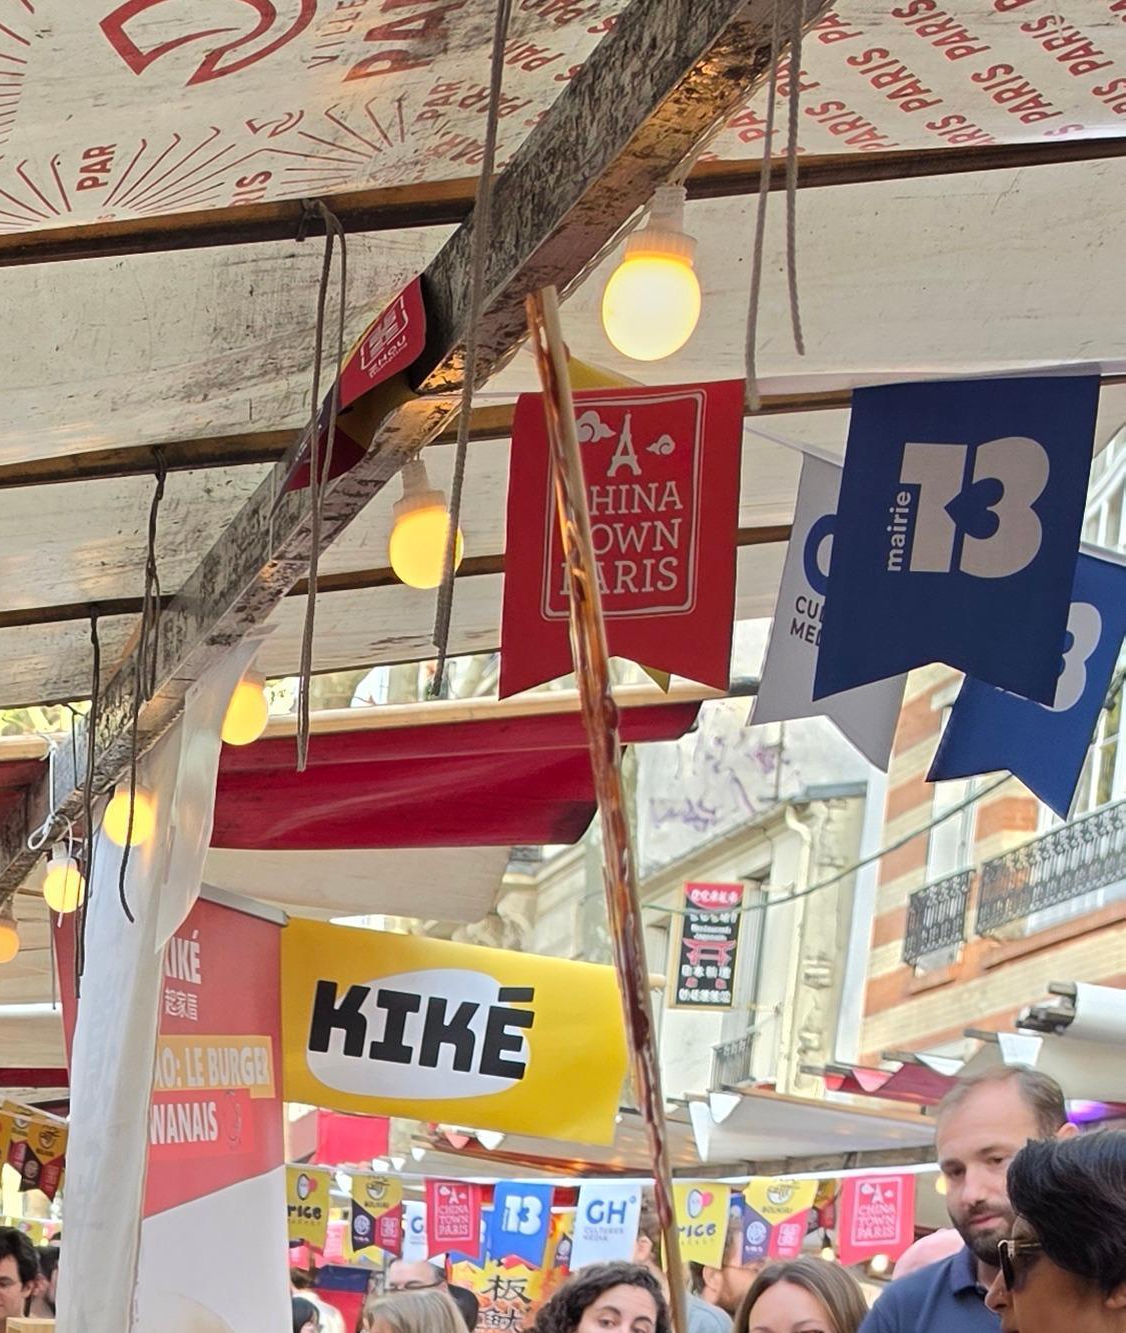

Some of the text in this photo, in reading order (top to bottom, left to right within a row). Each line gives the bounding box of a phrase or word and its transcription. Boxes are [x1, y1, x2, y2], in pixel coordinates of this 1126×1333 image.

[343, 0, 469, 82] PA
[890, 0, 991, 61] PARIS
[1020, 14, 1114, 76] PARIS
[846, 47, 943, 113] PARIS
[971, 64, 1063, 124] PARIS
[76, 143, 117, 191] PAR
[590, 481, 683, 515] HINA
[899, 436, 1050, 578] 13
[591, 519, 682, 554] OWN
[887, 491, 911, 571] mairie
[185, 1047, 204, 1087] LE
[207, 1046, 270, 1087] BURGER
[438, 1225, 468, 1236] PARIS
[439, 1215, 468, 1225] TOWN
[586, 1199, 627, 1224] GH
[857, 1226, 895, 1239] PARIS
[858, 1215, 894, 1227] TOWN
